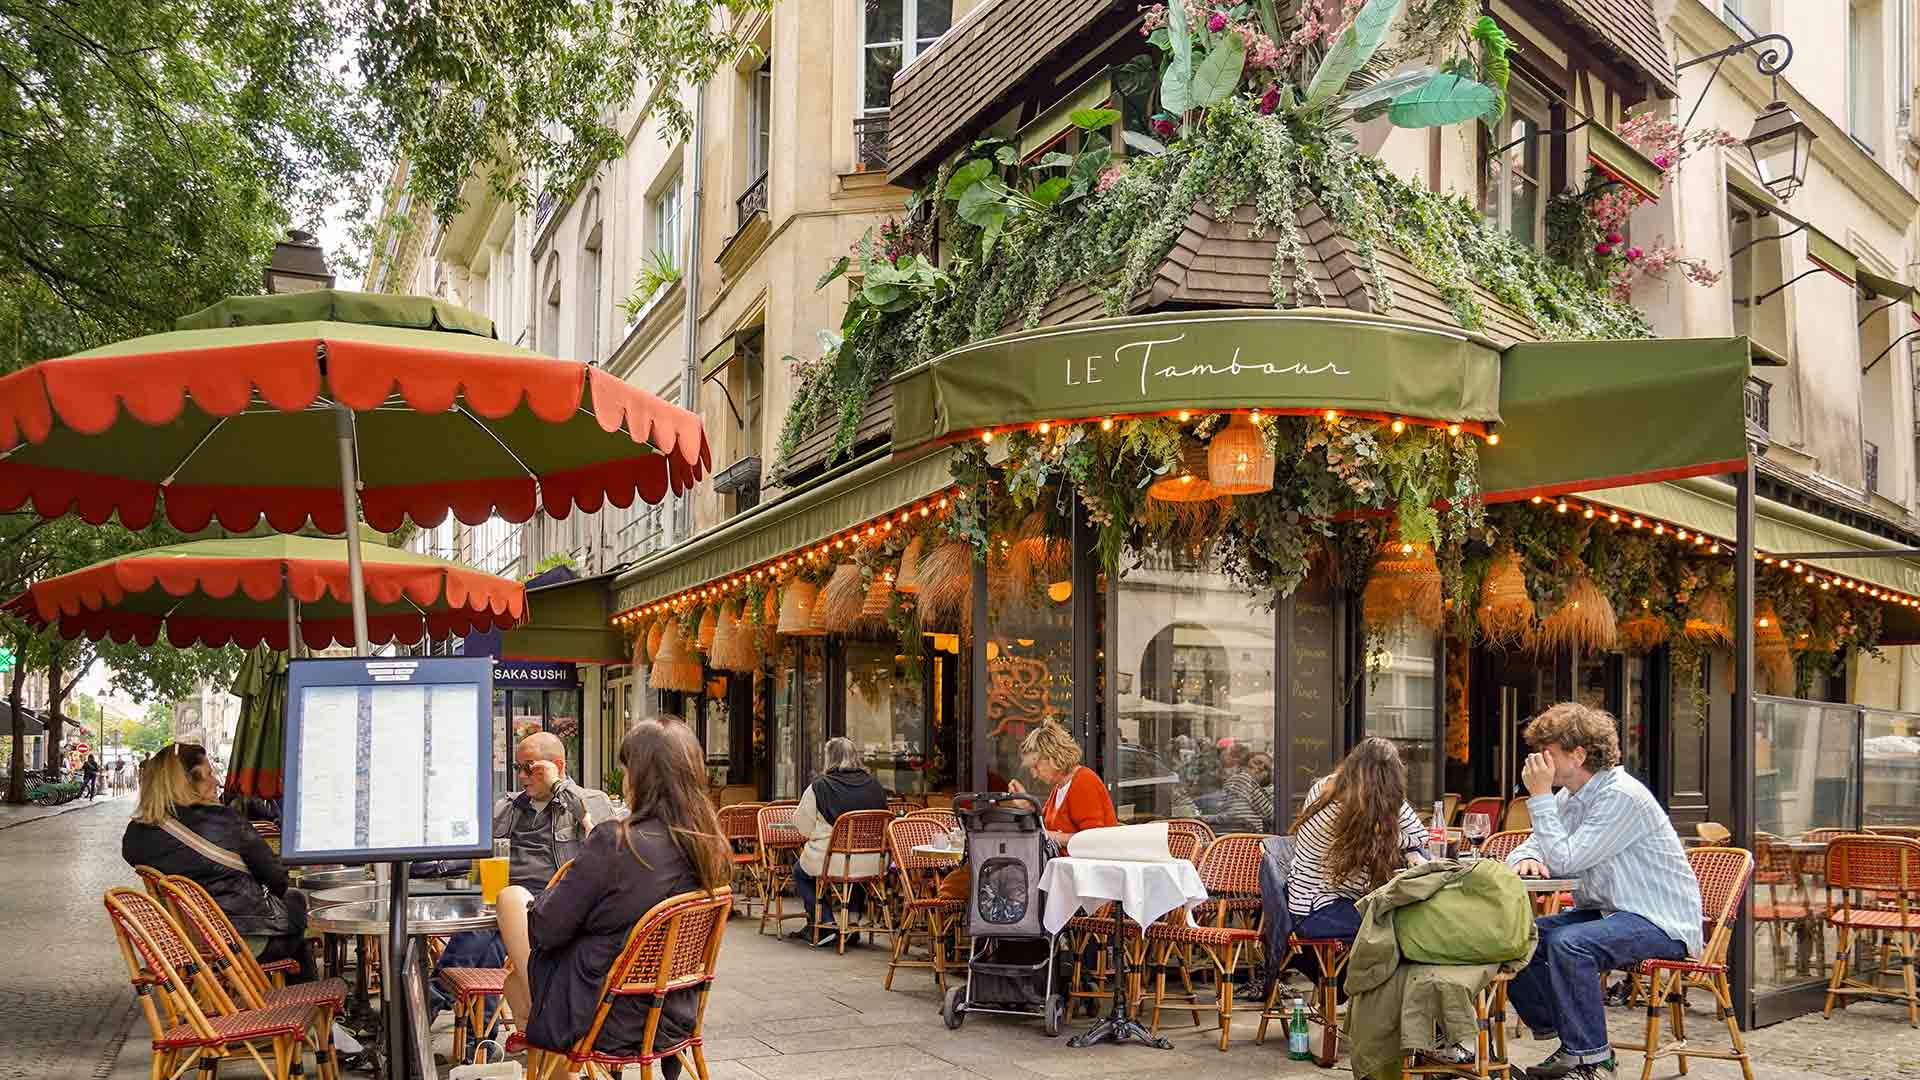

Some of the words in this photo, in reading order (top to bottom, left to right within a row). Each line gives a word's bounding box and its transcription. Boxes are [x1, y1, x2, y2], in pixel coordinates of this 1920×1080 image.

[1066, 355, 1103, 386] LE
[1114, 333, 1351, 396] Tambour
[494, 669, 528, 680] SAKA
[530, 669, 567, 680] SUSHI
